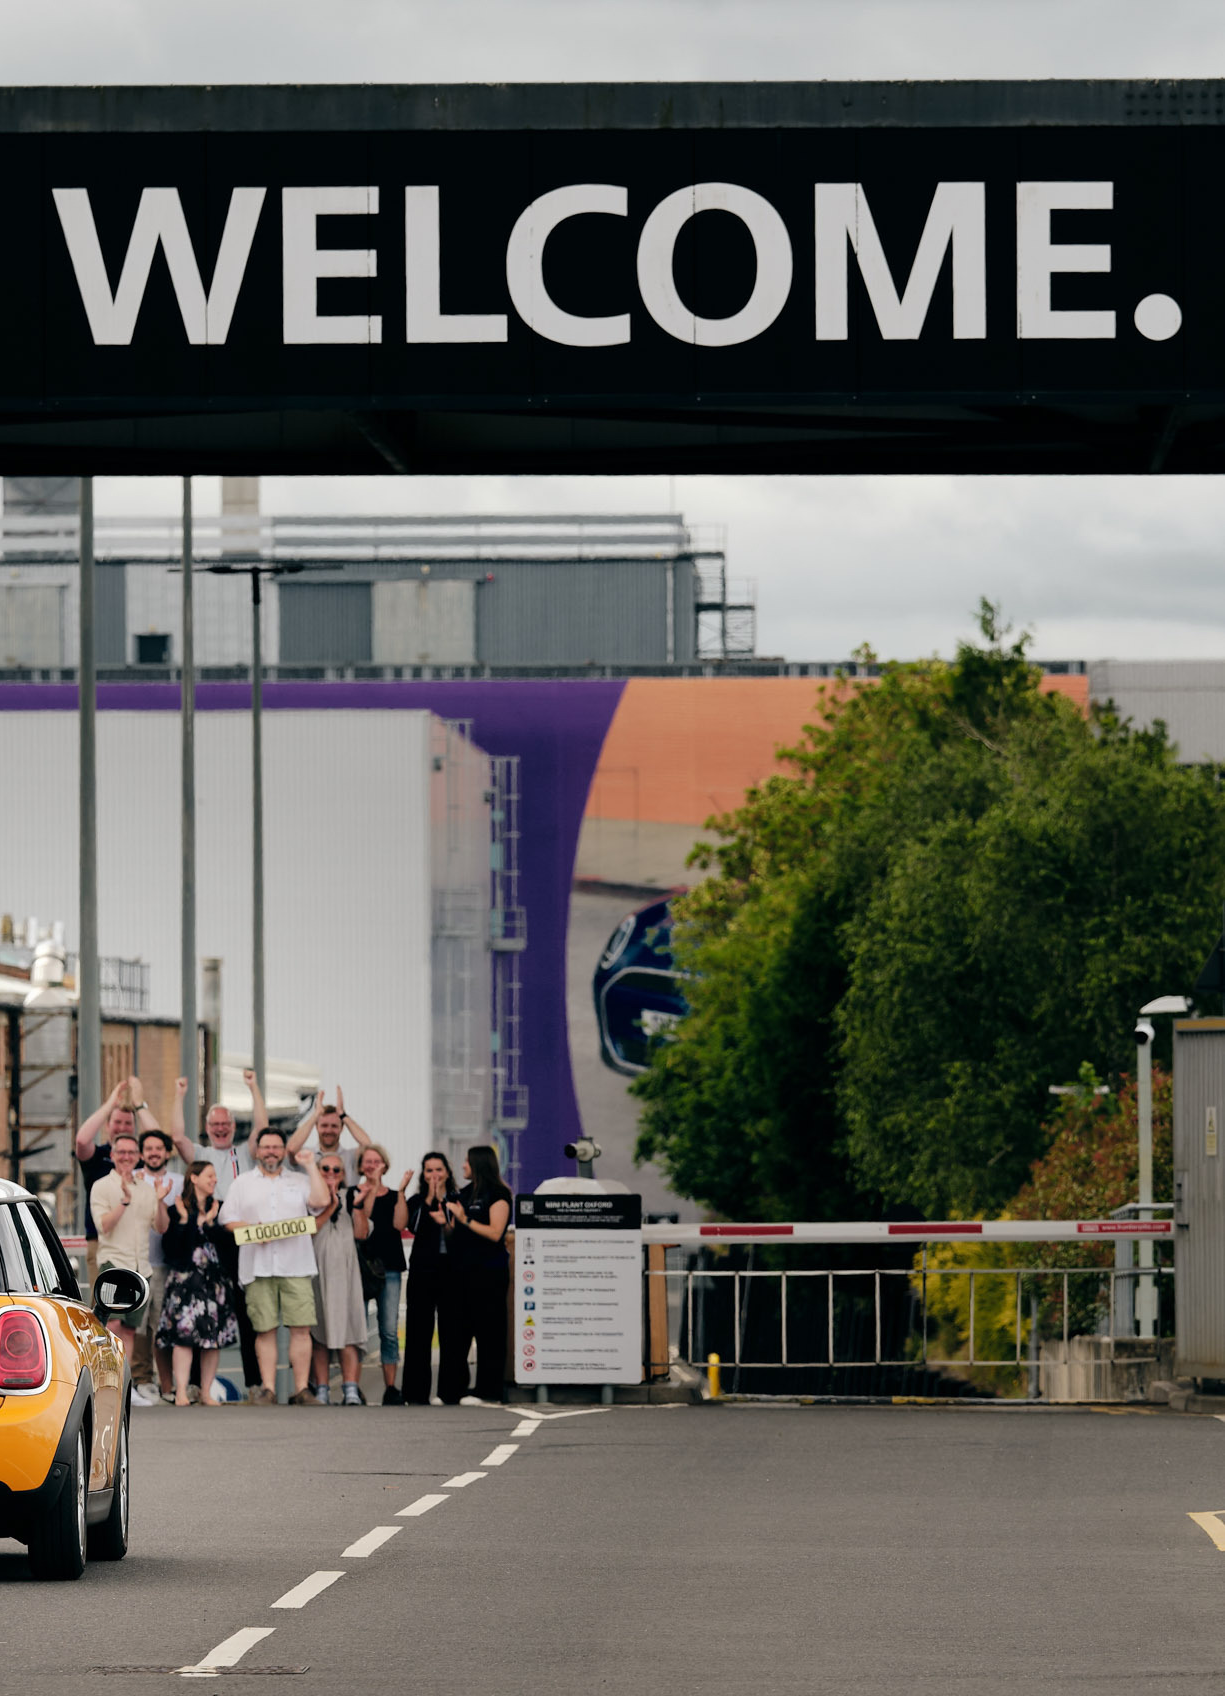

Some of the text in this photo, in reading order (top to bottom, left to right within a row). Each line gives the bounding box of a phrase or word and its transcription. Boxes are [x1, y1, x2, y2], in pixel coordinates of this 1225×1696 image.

[52, 182, 1182, 346] WELCOME.
[562, 1201, 583, 1209] PLANT
[584, 1201, 614, 1209] OXFORD
